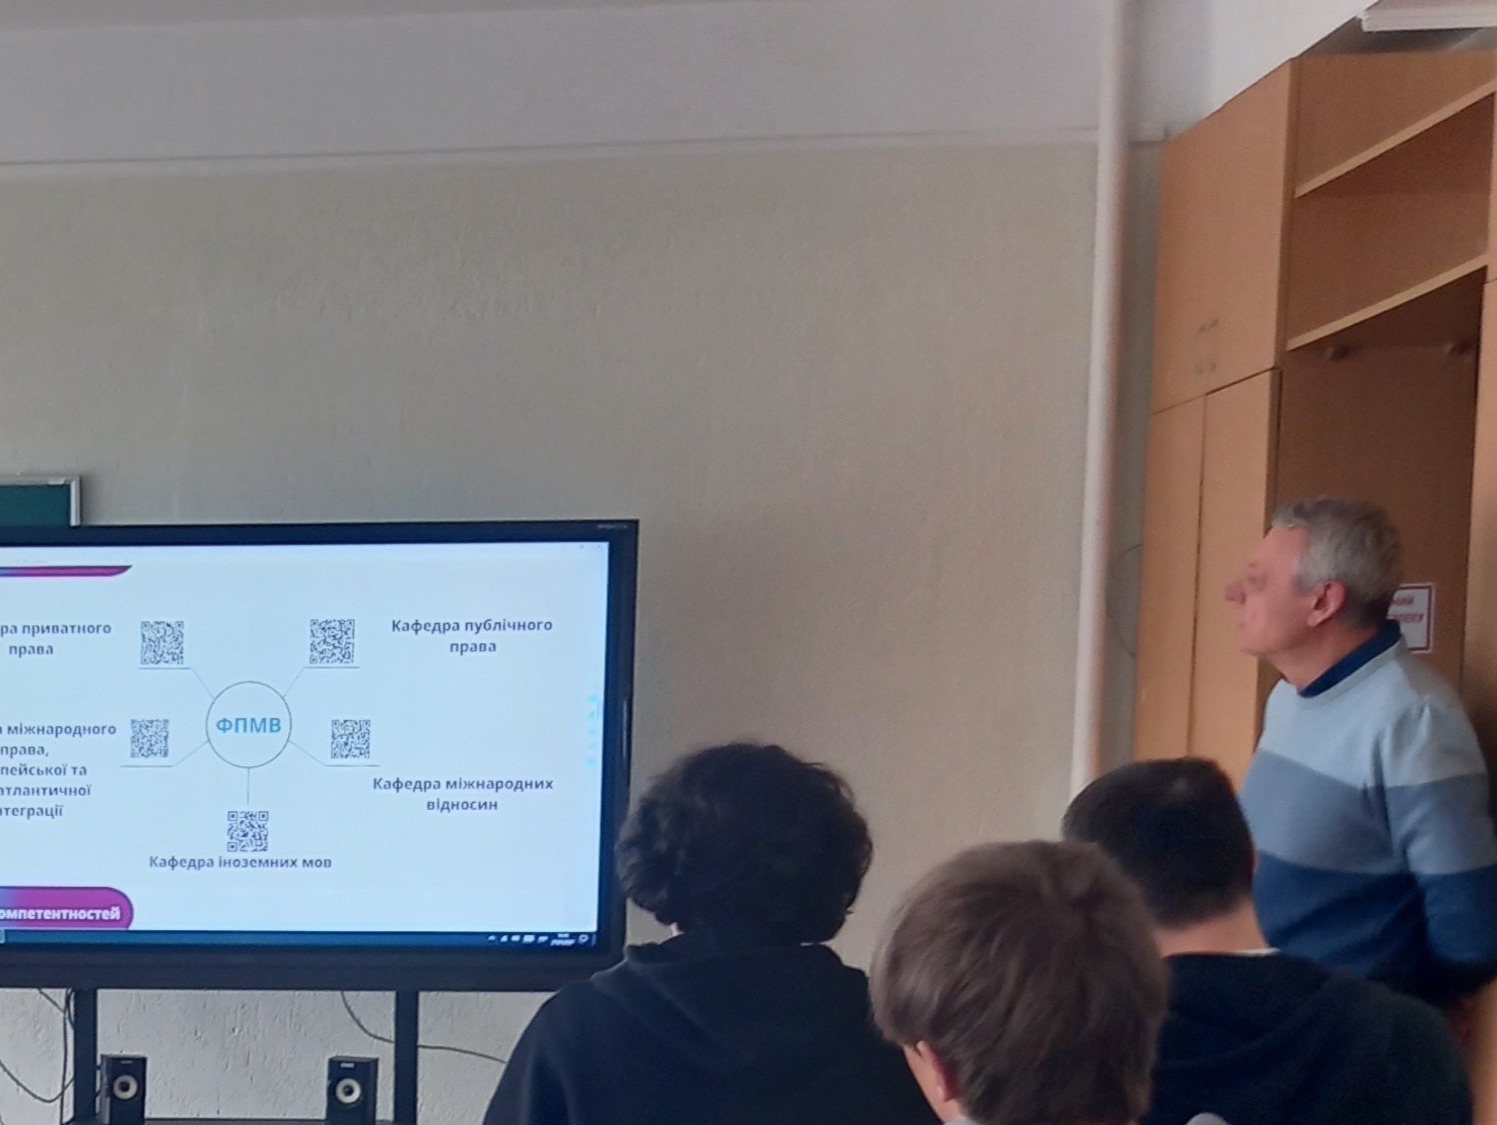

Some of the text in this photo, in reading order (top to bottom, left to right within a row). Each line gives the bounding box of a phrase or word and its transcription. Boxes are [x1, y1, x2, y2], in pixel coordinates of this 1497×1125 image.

[21, 623, 112, 638] приватного
[391, 618, 553, 635] Кафедра публічного
[8, 643, 54, 658] права
[449, 641, 497, 656] права
[6, 722, 117, 738] міжнародного
[215, 717, 282, 734] ФПМВ
[0, 744, 50, 759] права,
[70, 765, 88, 777] та
[372, 777, 555, 793] Кафедра міжнародних
[426, 798, 499, 813] відносин
[148, 855, 333, 871] Кафедра іноземних мов
